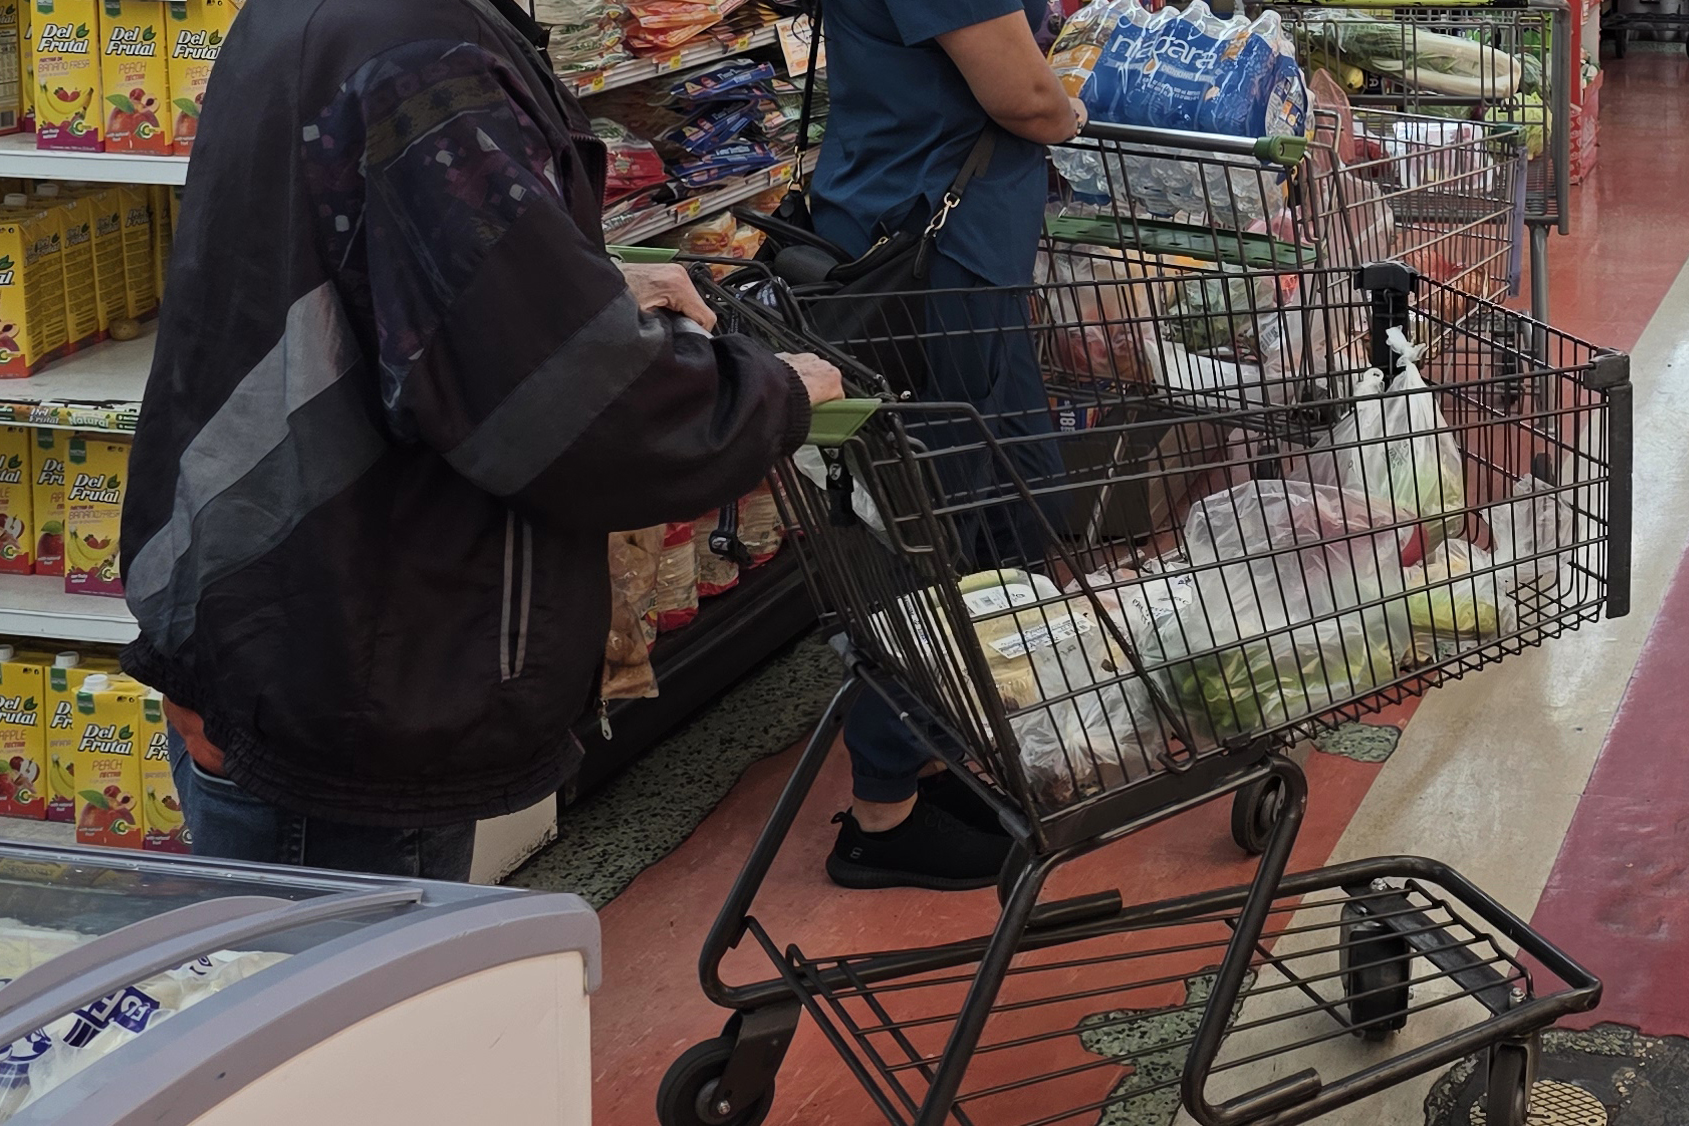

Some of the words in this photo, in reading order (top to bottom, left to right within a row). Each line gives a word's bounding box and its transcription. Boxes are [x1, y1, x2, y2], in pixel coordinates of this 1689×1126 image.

[43, 24, 73, 39] Del
[111, 26, 140, 42] Del
[177, 30, 206, 45] Del
[38, 38, 89, 54] Frutal
[105, 41, 156, 57] Frutal
[1111, 34, 1217, 70] niagara
[74, 474, 104, 489] Del
[68, 486, 120, 504] Frutal
[83, 725, 116, 740] Del
[78, 738, 133, 755] Frutal
